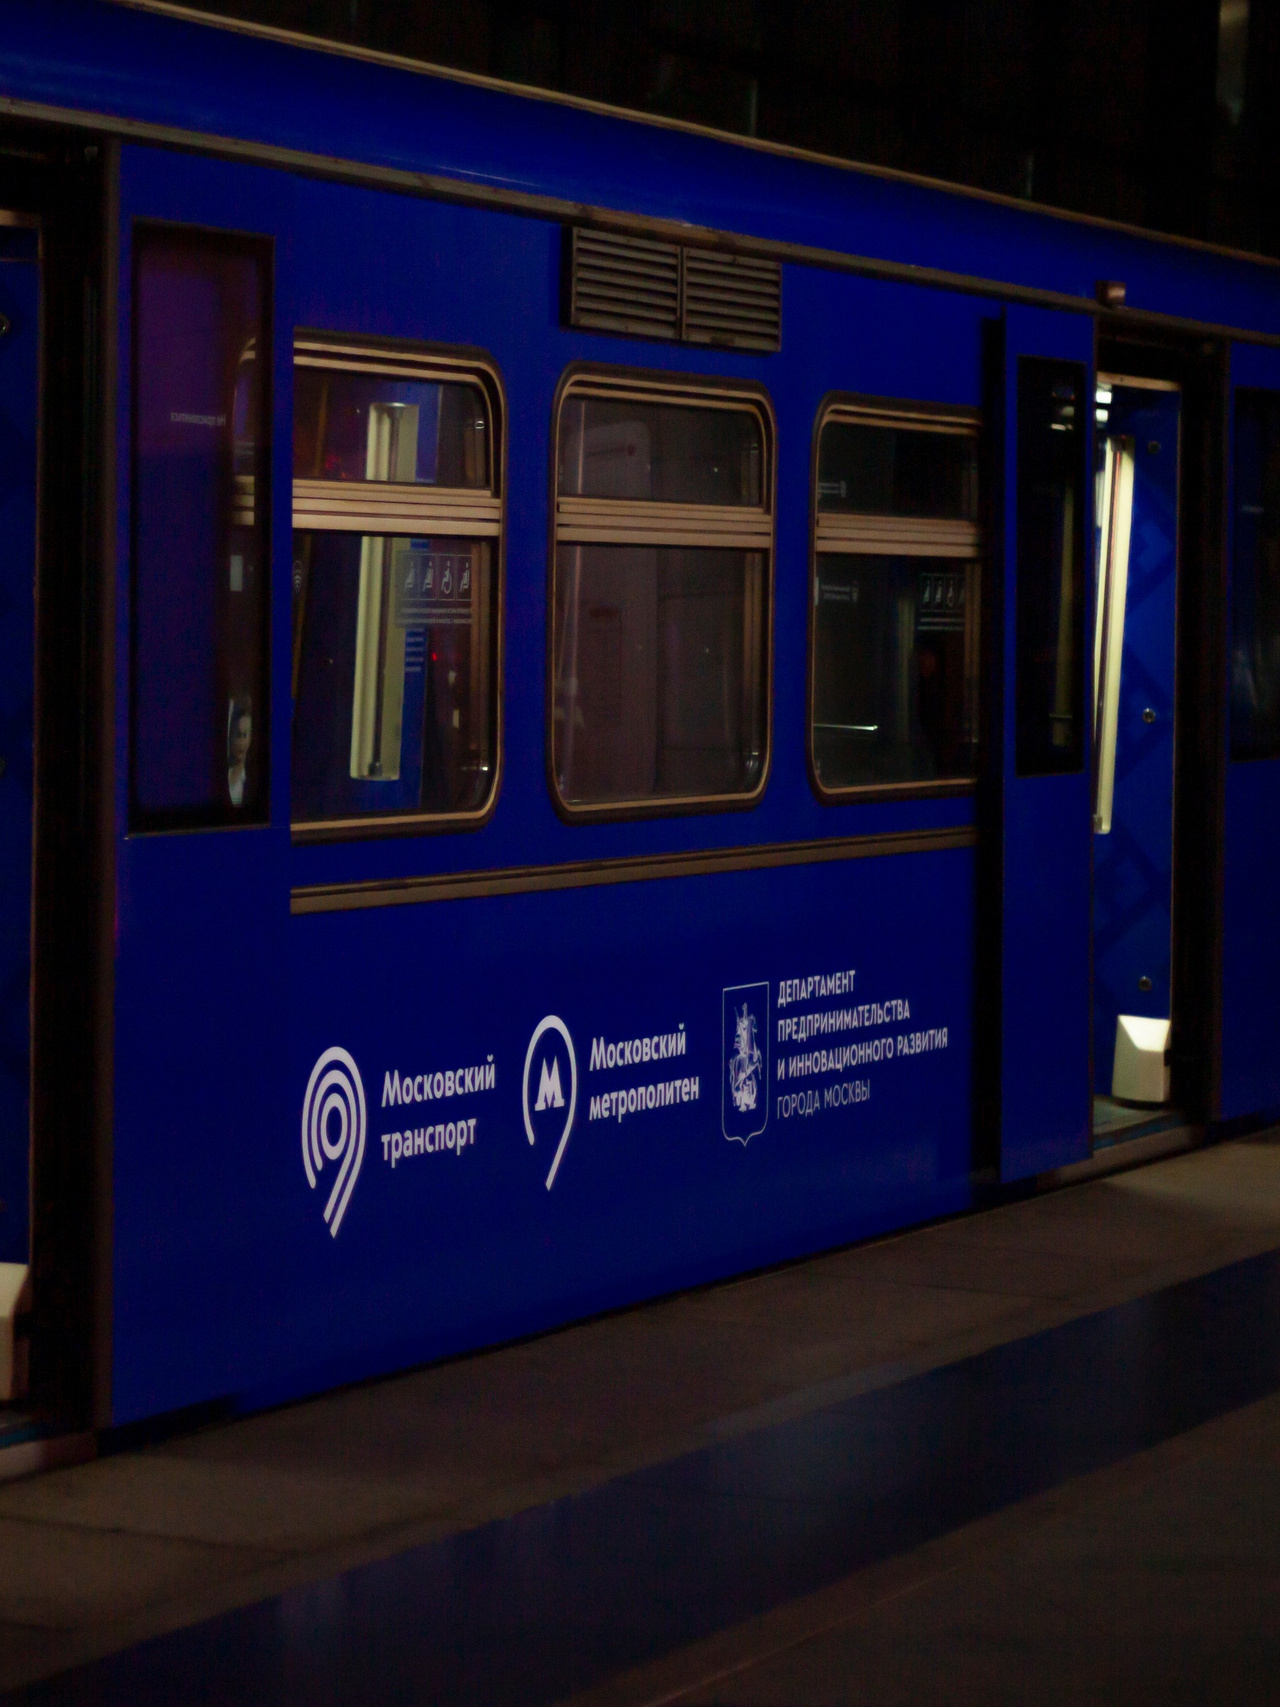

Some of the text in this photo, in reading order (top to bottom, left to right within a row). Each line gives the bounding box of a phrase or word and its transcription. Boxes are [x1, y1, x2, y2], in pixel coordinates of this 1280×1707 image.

[777, 969, 856, 1008] ДЕПАРТАМЕНТ
[777, 998, 911, 1043] ПРЕДПРИНИМАТЕЛЬСТВА
[589, 1022, 687, 1072] Московский
[777, 1026, 949, 1081] И ИННОВАЦИОННОГО РАЗВИТИЯ
[381, 1053, 497, 1108] Московский
[588, 1076, 700, 1123] метрополитен
[777, 1078, 871, 1120] ГОРОДА МОСКВЫ
[380, 1117, 478, 1168] транспорт
